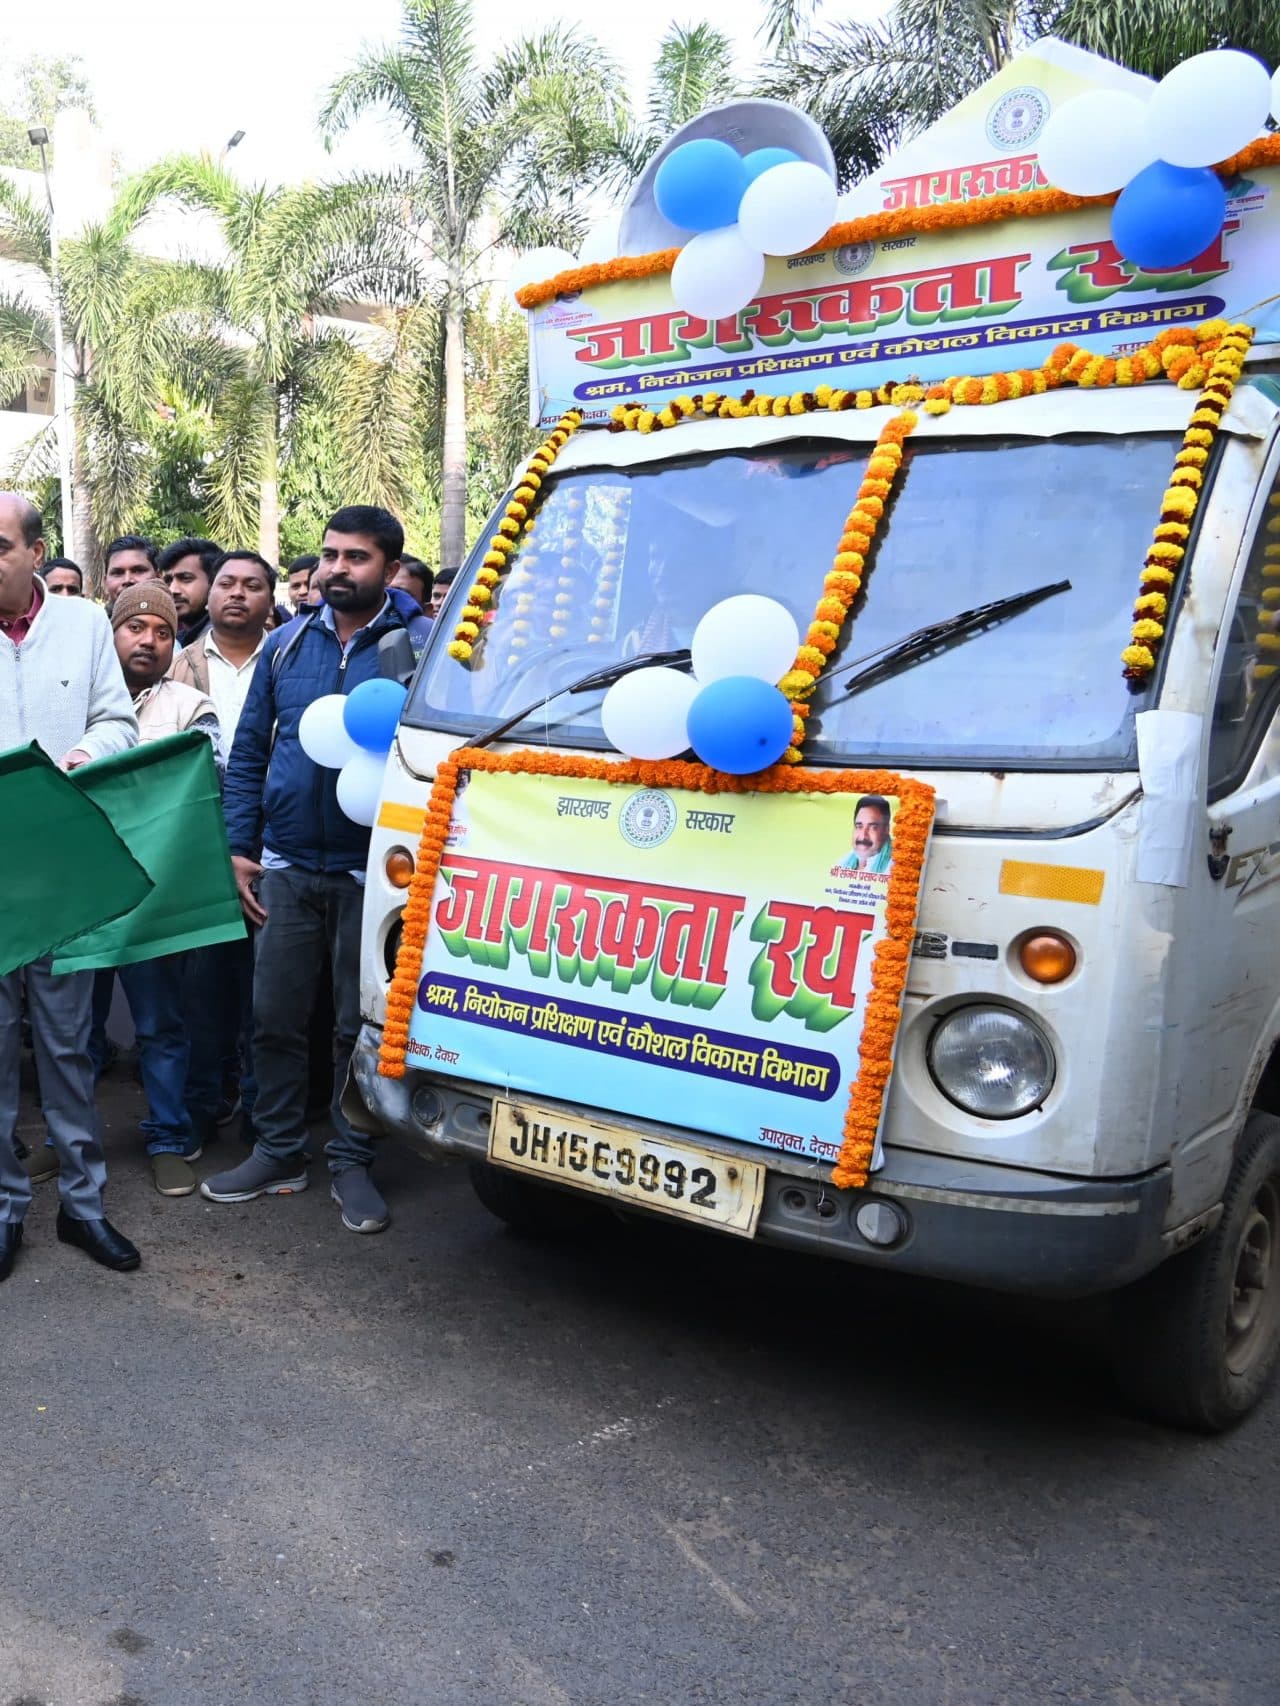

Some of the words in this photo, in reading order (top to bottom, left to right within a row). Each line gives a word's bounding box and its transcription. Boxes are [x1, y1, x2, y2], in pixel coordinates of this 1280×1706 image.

[880, 153, 1049, 209] जागरूक
[881, 237, 917, 251] सरकार
[638, 368, 734, 390] नियोजन
[738, 351, 834, 378] प्रशिक्षण
[839, 343, 880, 362] एवं
[884, 332, 981, 356] कौशल
[984, 318, 1092, 343] विकास
[1098, 303, 1207, 329] विभाग
[556, 796, 611, 819] झारखण्ड
[685, 810, 735, 833] सरकार
[766, 900, 875, 1009] रथ
[426, 984, 458, 1013] श्रम,
[463, 985, 530, 1025] नियोजन
[531, 1002, 596, 1040] प्रशिक्षण
[598, 1017, 628, 1047] एवं
[627, 1021, 690, 1061] कौशल
[691, 1033, 759, 1076] विकास
[761, 1047, 830, 1091] विभाग
[435, 1045, 460, 1065] देवघर
